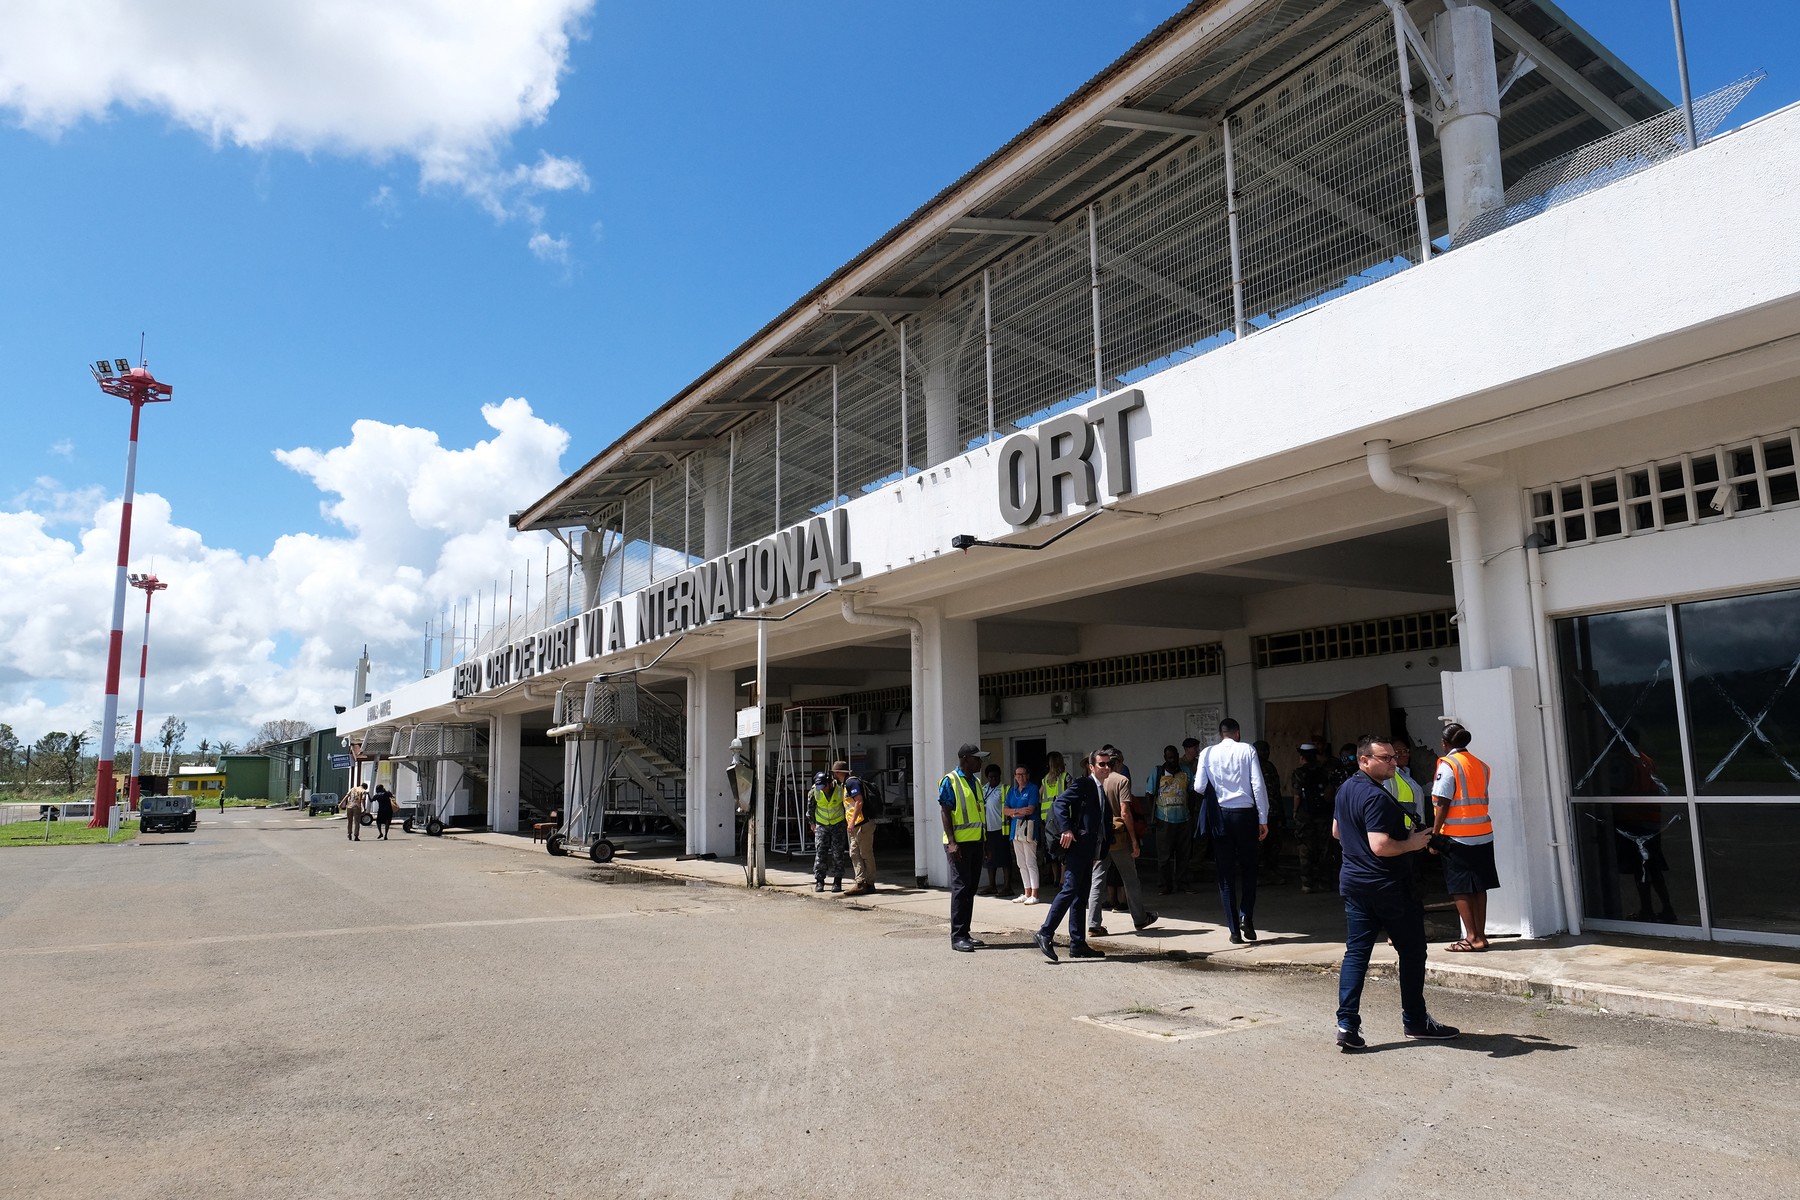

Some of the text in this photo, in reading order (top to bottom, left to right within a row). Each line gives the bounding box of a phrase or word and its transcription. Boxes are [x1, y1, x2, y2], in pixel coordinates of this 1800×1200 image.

[452, 659, 482, 698] AERO
[485, 644, 513, 689] ORT
[513, 636, 536, 681] DE
[536, 617, 580, 674] PORT
[636, 507, 862, 644] NTERNATIONAL
[997, 388, 1145, 527] ORT
